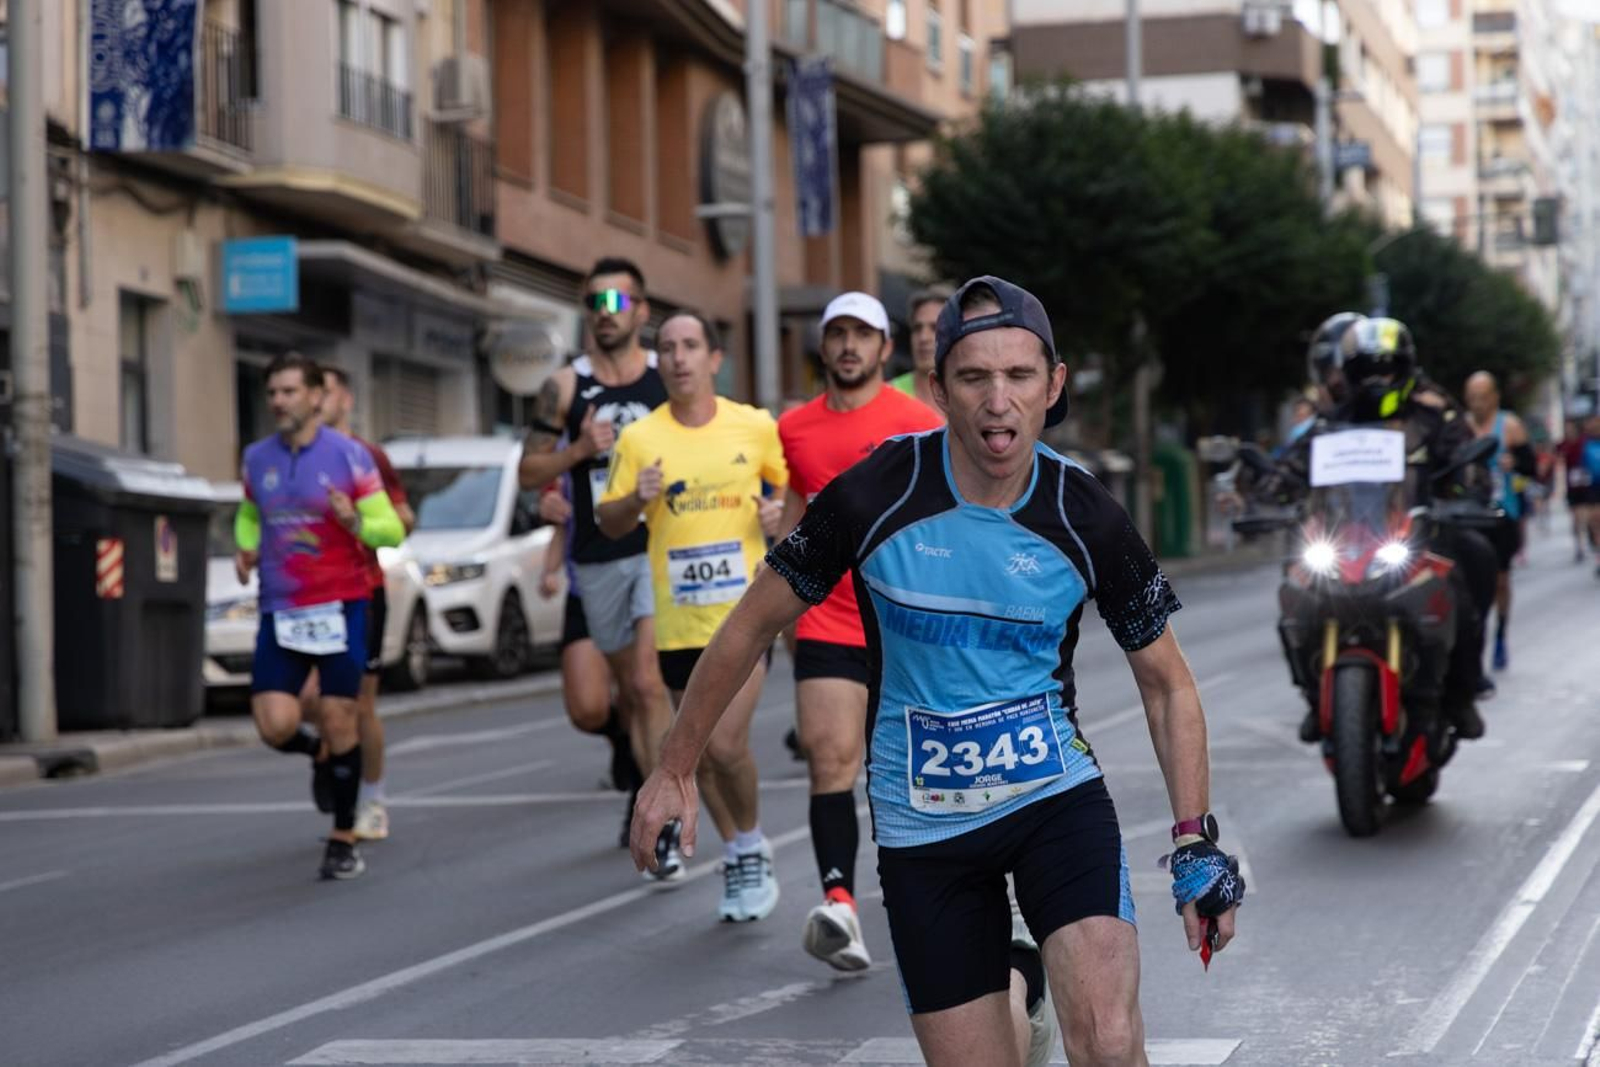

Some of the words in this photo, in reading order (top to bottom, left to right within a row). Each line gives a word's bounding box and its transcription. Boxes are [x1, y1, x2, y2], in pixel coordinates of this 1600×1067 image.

[925, 547, 952, 558] TACTIC
[683, 559, 731, 581] 404
[1003, 605, 1046, 621] BAENA
[885, 604, 970, 648] MEDIA
[921, 726, 1049, 776] 2343
[974, 774, 1003, 784] JORGE
